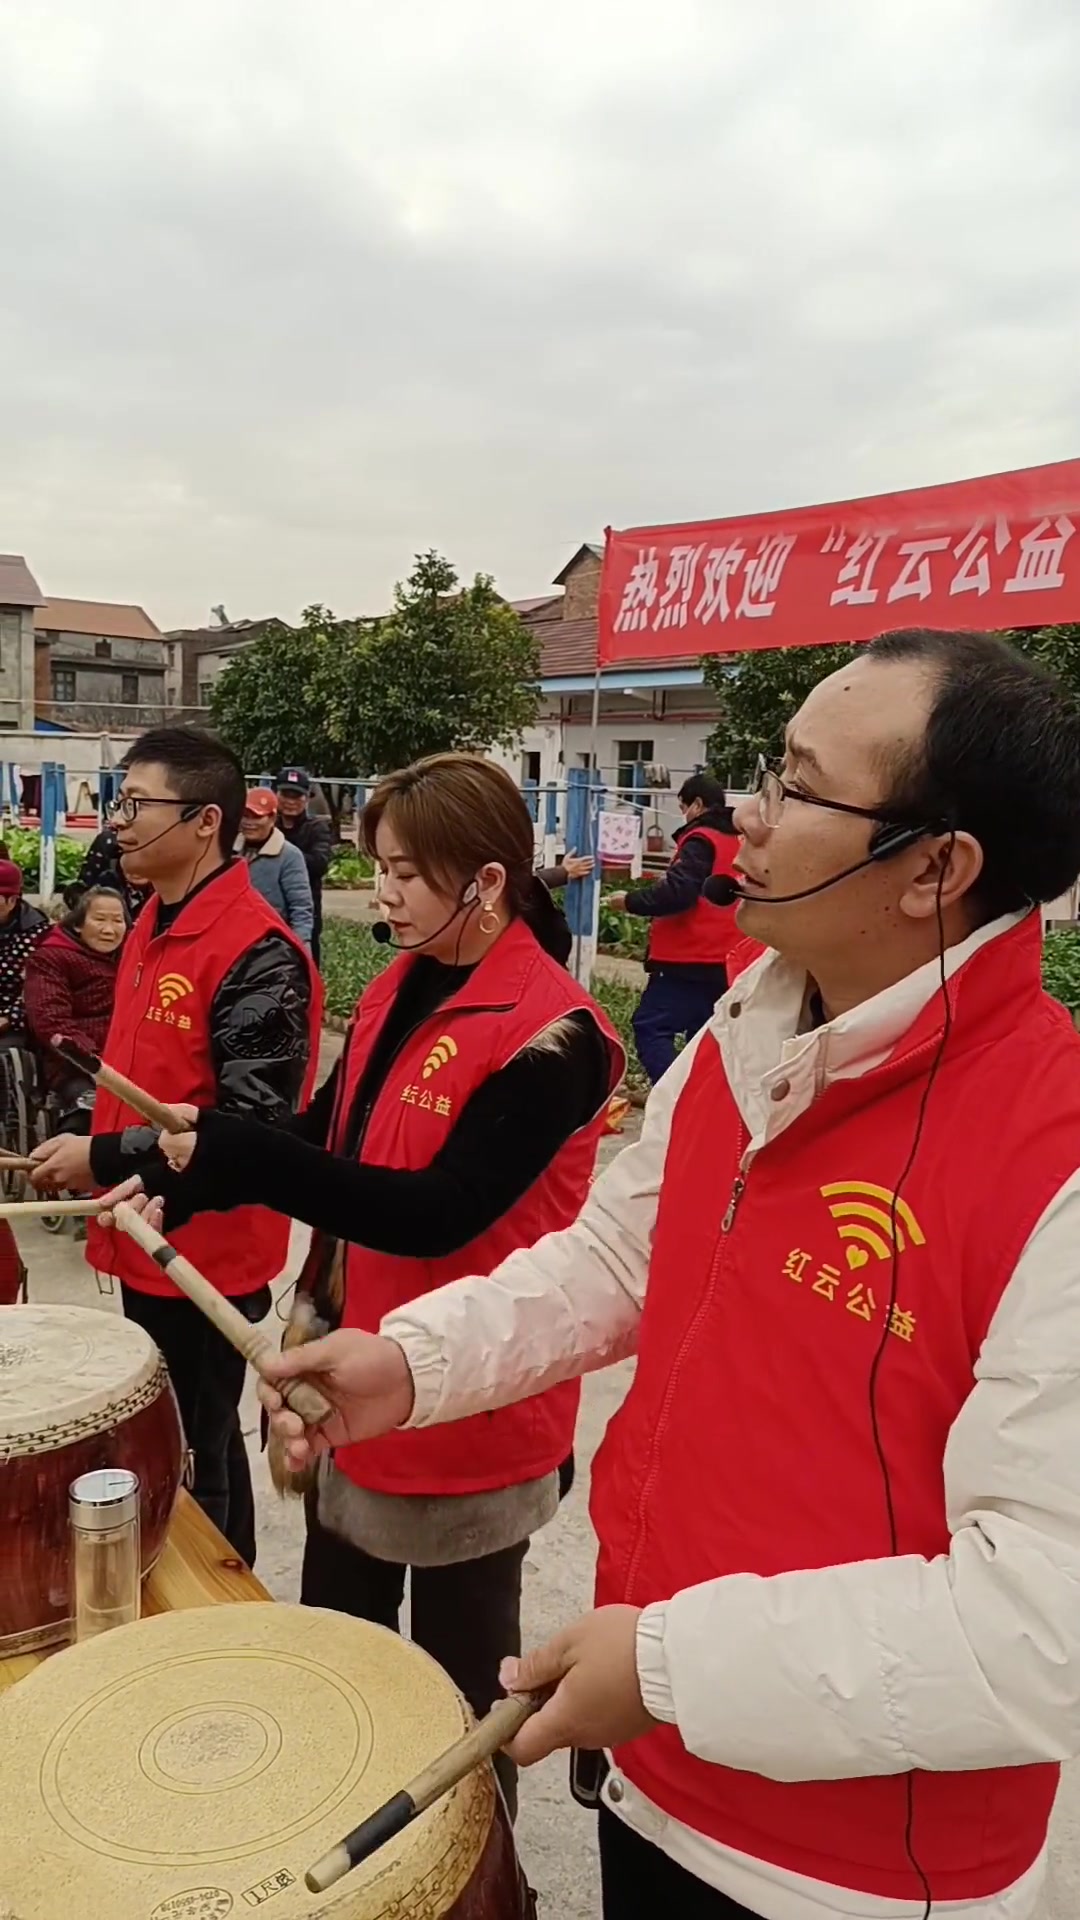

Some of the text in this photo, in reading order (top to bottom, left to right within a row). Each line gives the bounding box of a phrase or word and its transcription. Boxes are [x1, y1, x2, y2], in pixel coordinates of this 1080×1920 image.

[613, 531, 798, 633] 热烈欢迎
[781, 1247, 917, 1342] 红云公益
